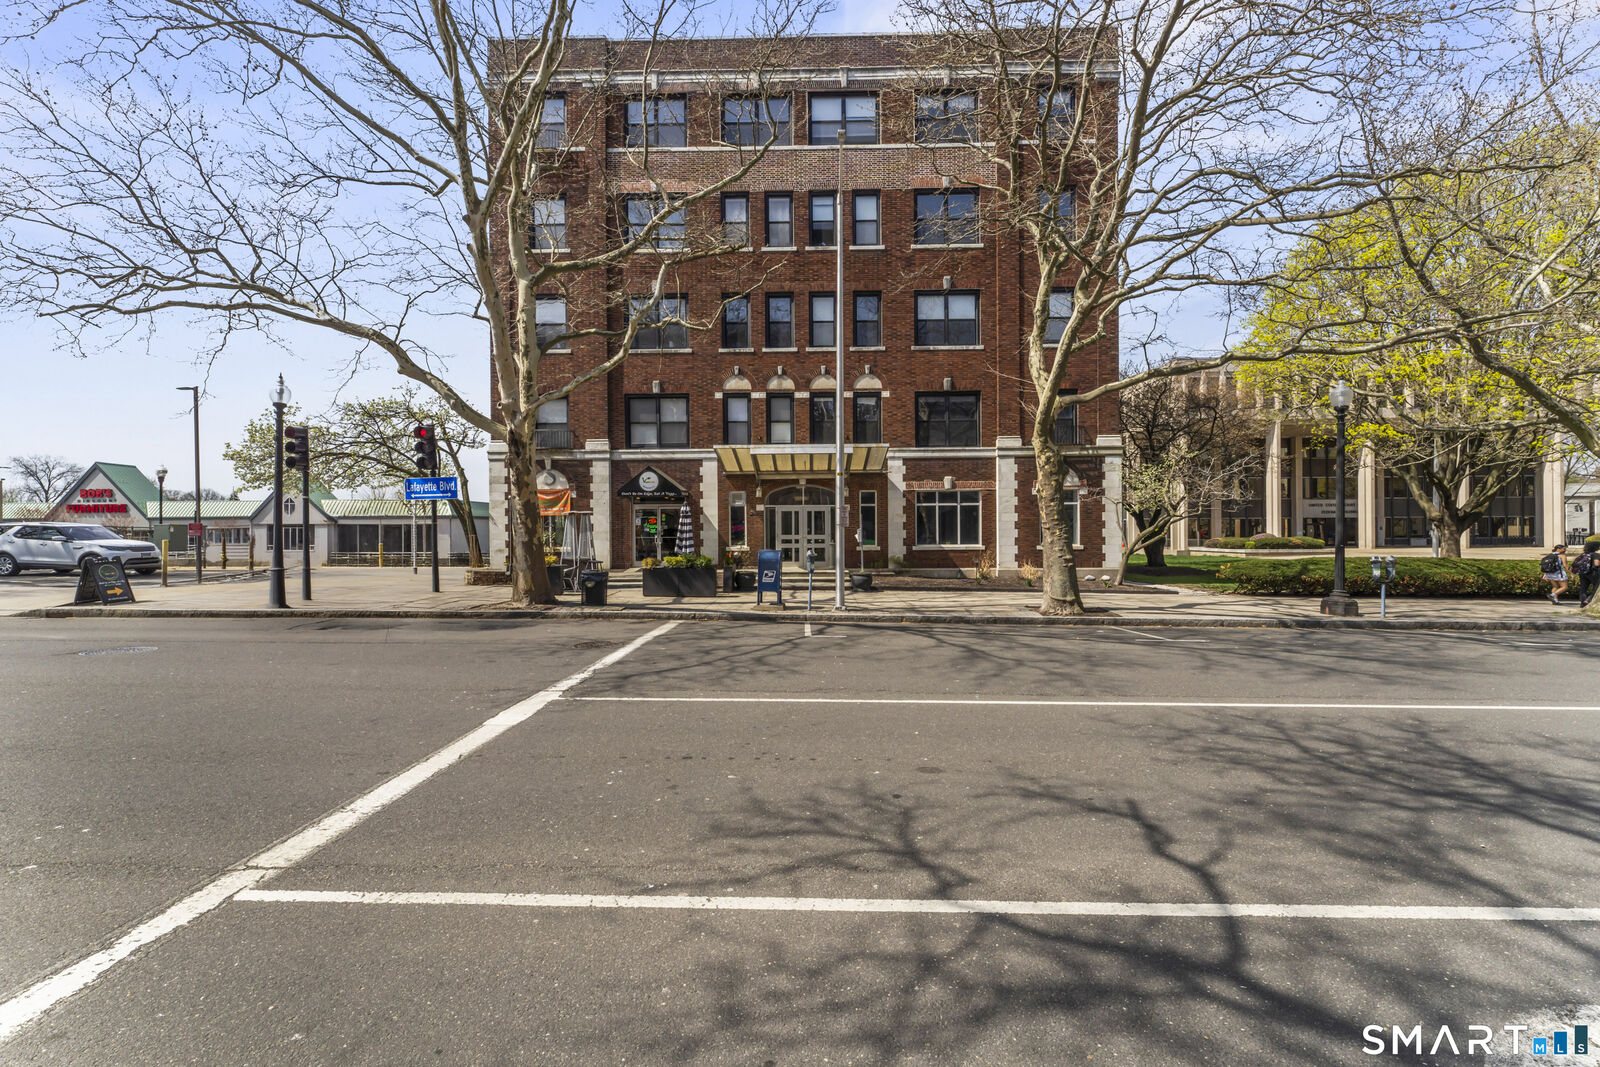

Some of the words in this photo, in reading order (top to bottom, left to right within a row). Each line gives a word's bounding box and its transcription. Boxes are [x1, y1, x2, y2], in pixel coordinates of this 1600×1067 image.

[406, 482, 437, 494] Lafayette
[439, 481, 456, 491] Blvd.
[80, 489, 113, 498] BOB'S
[66, 504, 128, 513] FURNITURE
